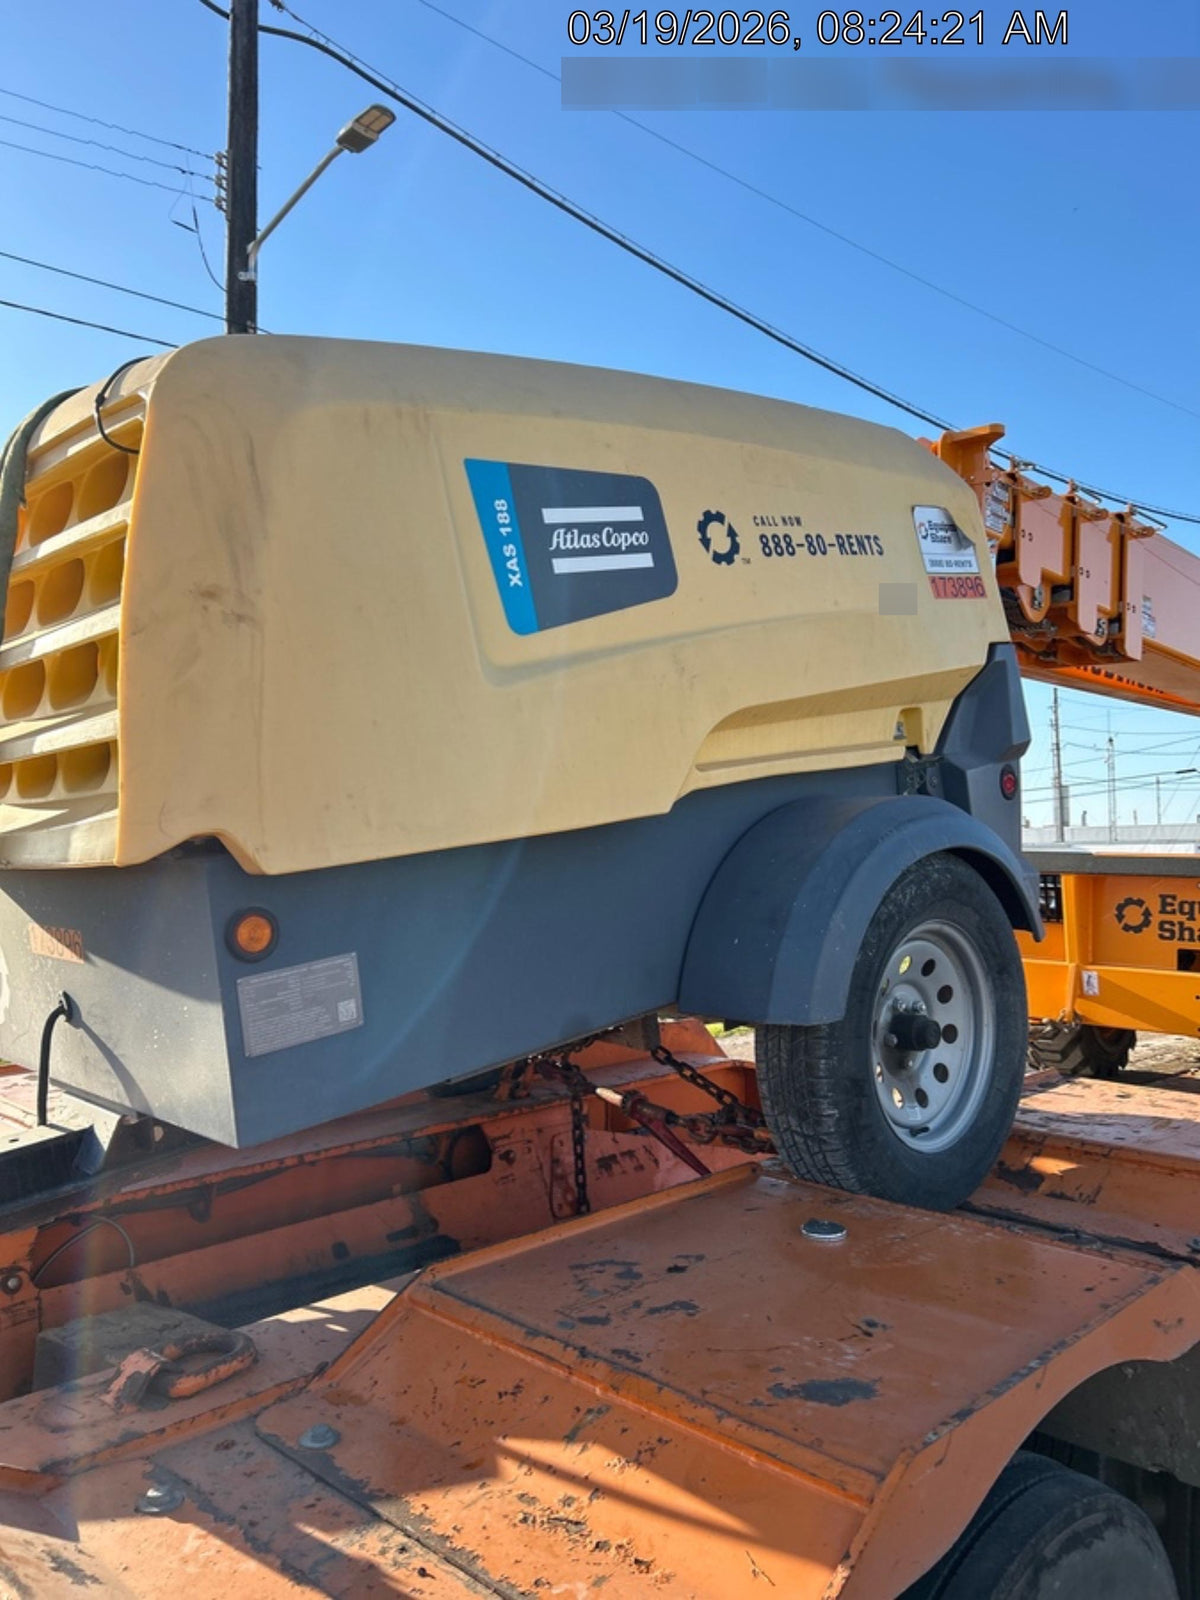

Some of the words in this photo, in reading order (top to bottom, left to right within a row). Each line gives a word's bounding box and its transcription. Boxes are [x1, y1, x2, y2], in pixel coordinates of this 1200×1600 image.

[494, 499, 513, 536] 188
[753, 515, 777, 527] CALL
[782, 515, 803, 527] NOW
[759, 533, 884, 557] 888-80-RENTS
[503, 544, 523, 587] XAS
[930, 576, 985, 598] 173896
